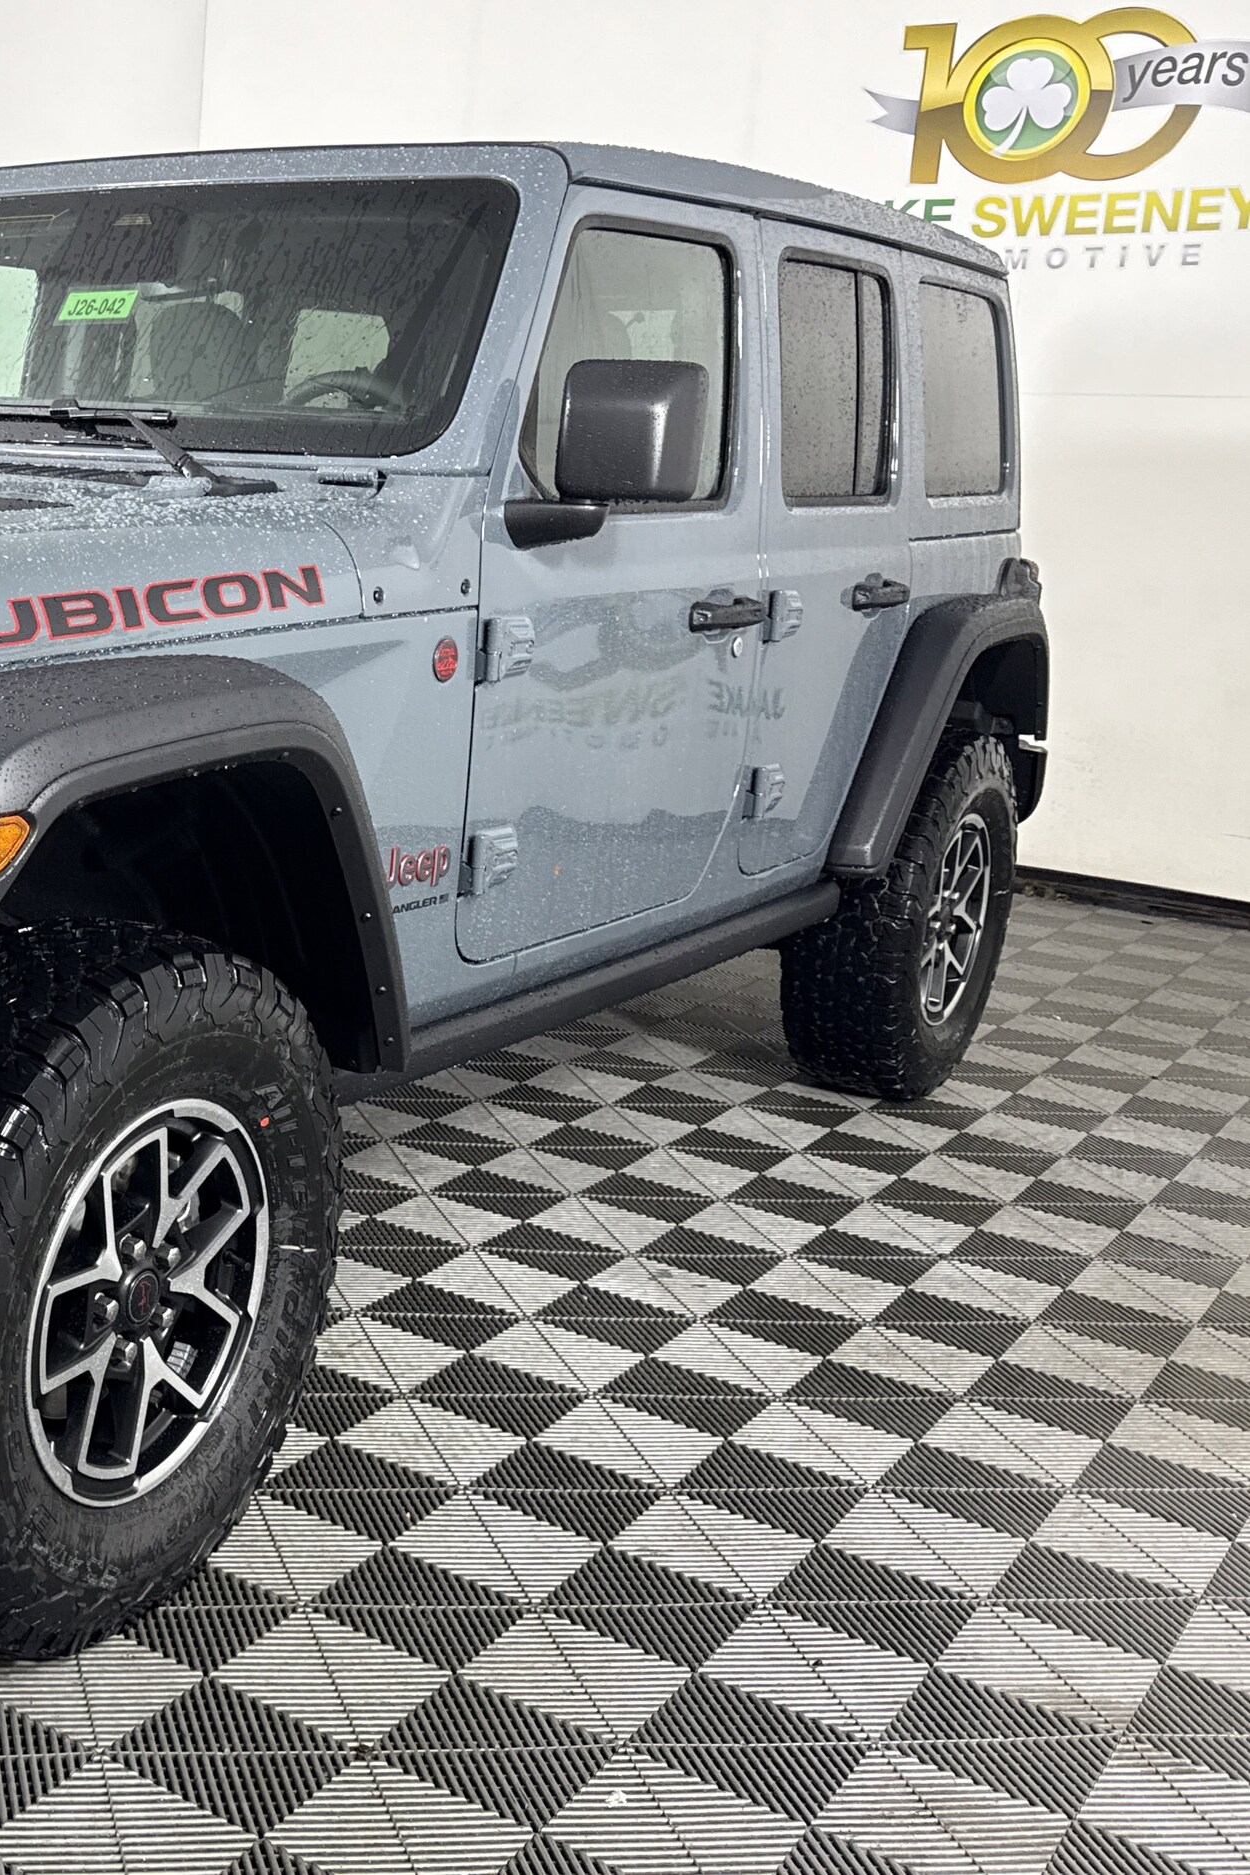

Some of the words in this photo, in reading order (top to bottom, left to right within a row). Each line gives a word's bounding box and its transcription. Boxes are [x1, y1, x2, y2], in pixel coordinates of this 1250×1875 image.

[903, 7, 1202, 184] 100
[1122, 51, 1249, 103] years
[971, 187, 1250, 238] SWEENEY
[1004, 244, 1201, 271] MOTIVE
[67, 298, 126, 316] J26-042
[386, 845, 451, 887] Jeep
[393, 896, 438, 914] ANGLER
